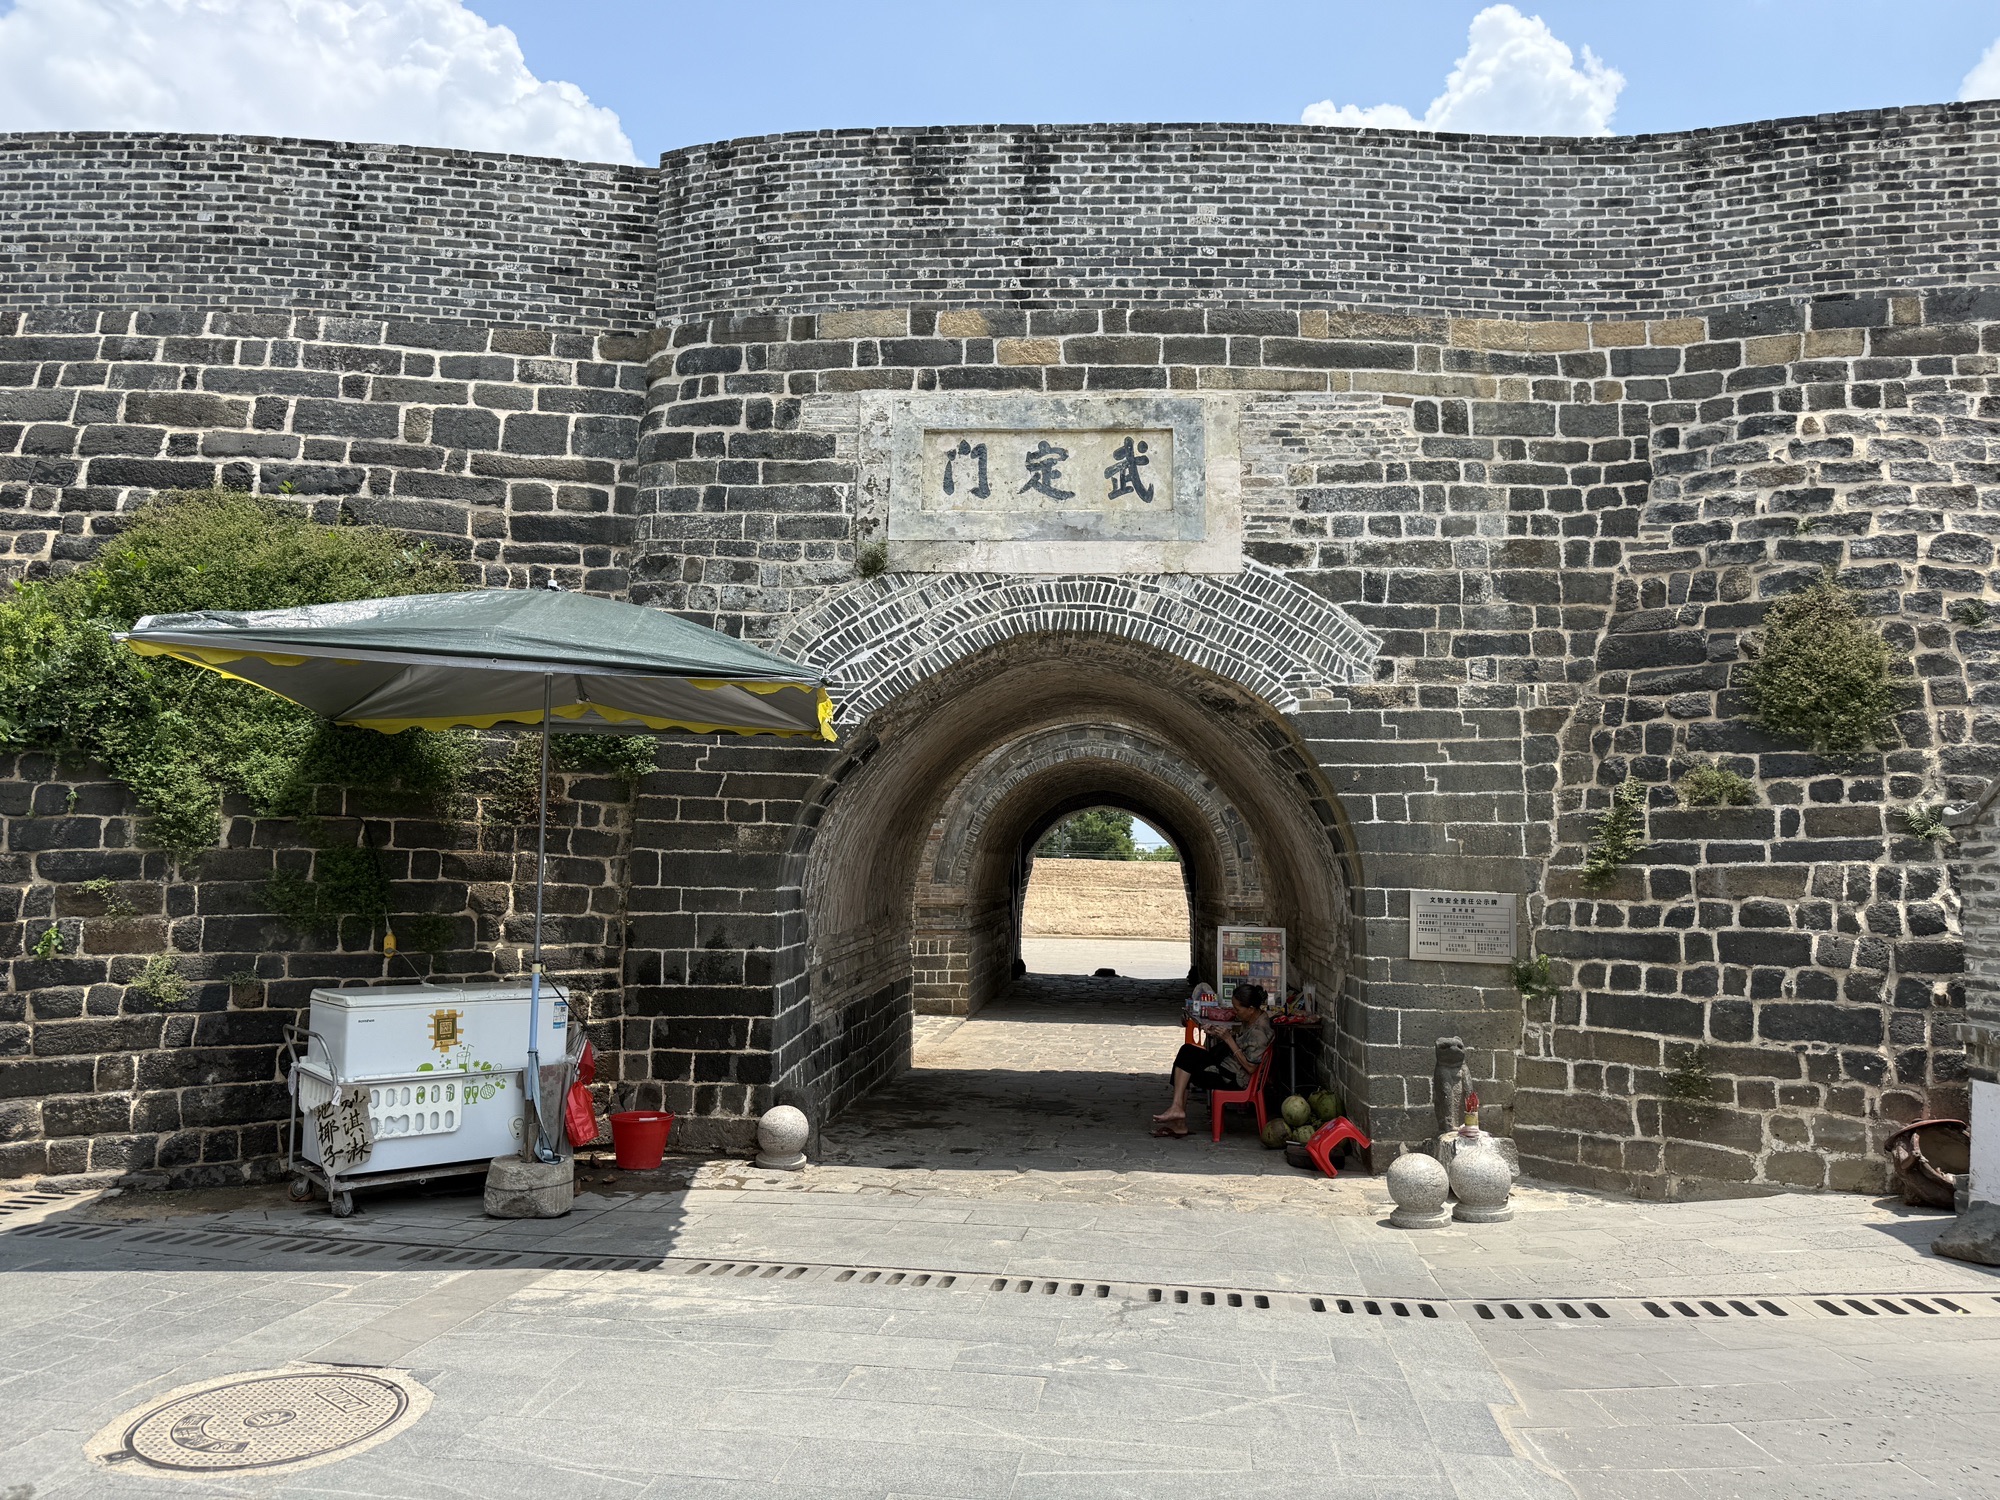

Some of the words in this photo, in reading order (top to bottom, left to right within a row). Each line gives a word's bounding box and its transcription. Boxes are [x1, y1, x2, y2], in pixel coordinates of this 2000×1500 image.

[942, 436, 1155, 503] 武定门
[1429, 896, 1498, 906] 文物安全责任公示牌
